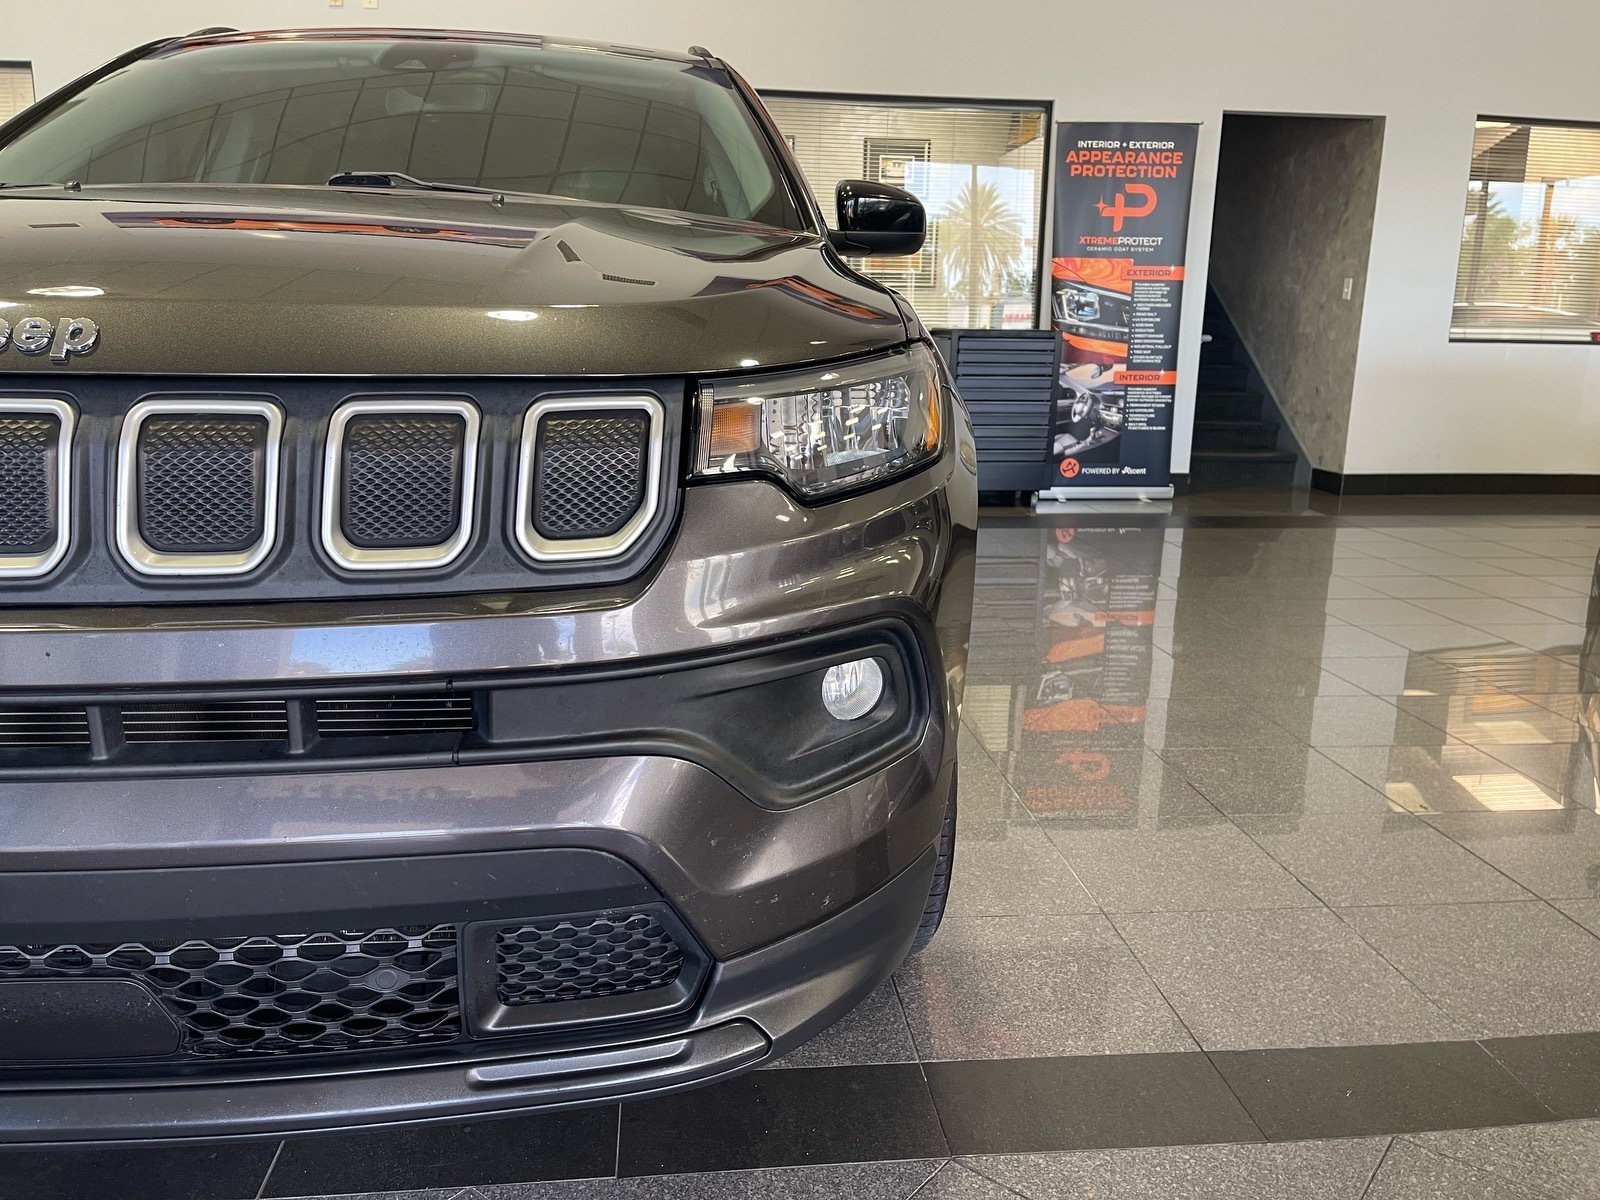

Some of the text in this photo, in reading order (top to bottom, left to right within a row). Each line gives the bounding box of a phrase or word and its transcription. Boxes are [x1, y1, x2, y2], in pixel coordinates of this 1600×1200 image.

[1077, 140, 1175, 149] INTERIOR EXTERIOR
[1065, 150, 1184, 165] APPEARANCE
[1070, 164, 1177, 178] PROTECTION
[1126, 269, 1172, 277] EXTERIOR
[0, 317, 99, 362] ep
[1081, 467, 1111, 475] POWERED
[1111, 467, 1120, 475] BY
